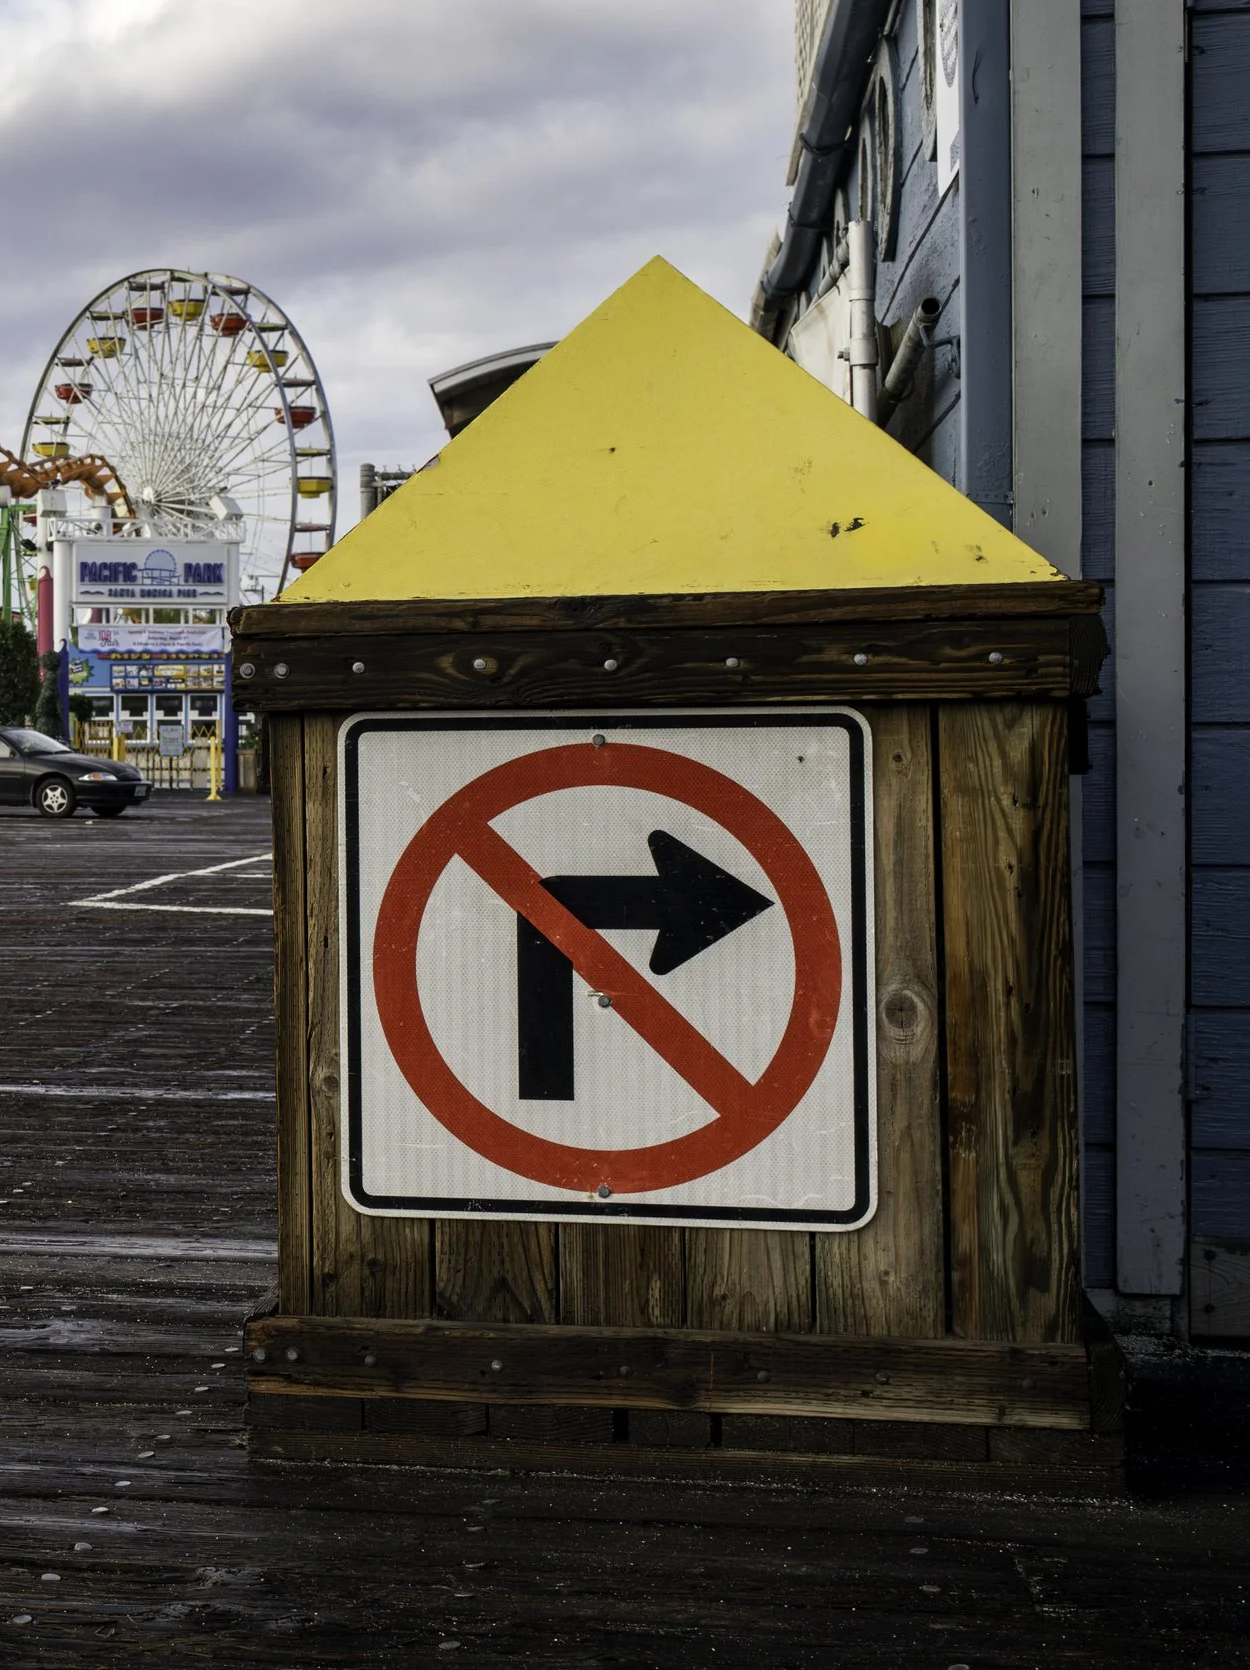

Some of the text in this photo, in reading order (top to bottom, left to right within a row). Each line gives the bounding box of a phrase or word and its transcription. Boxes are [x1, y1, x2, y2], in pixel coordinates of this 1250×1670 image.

[80, 561, 224, 584] PACIFIC PARK
[108, 588, 198, 598] SANTA MONICA PIER
